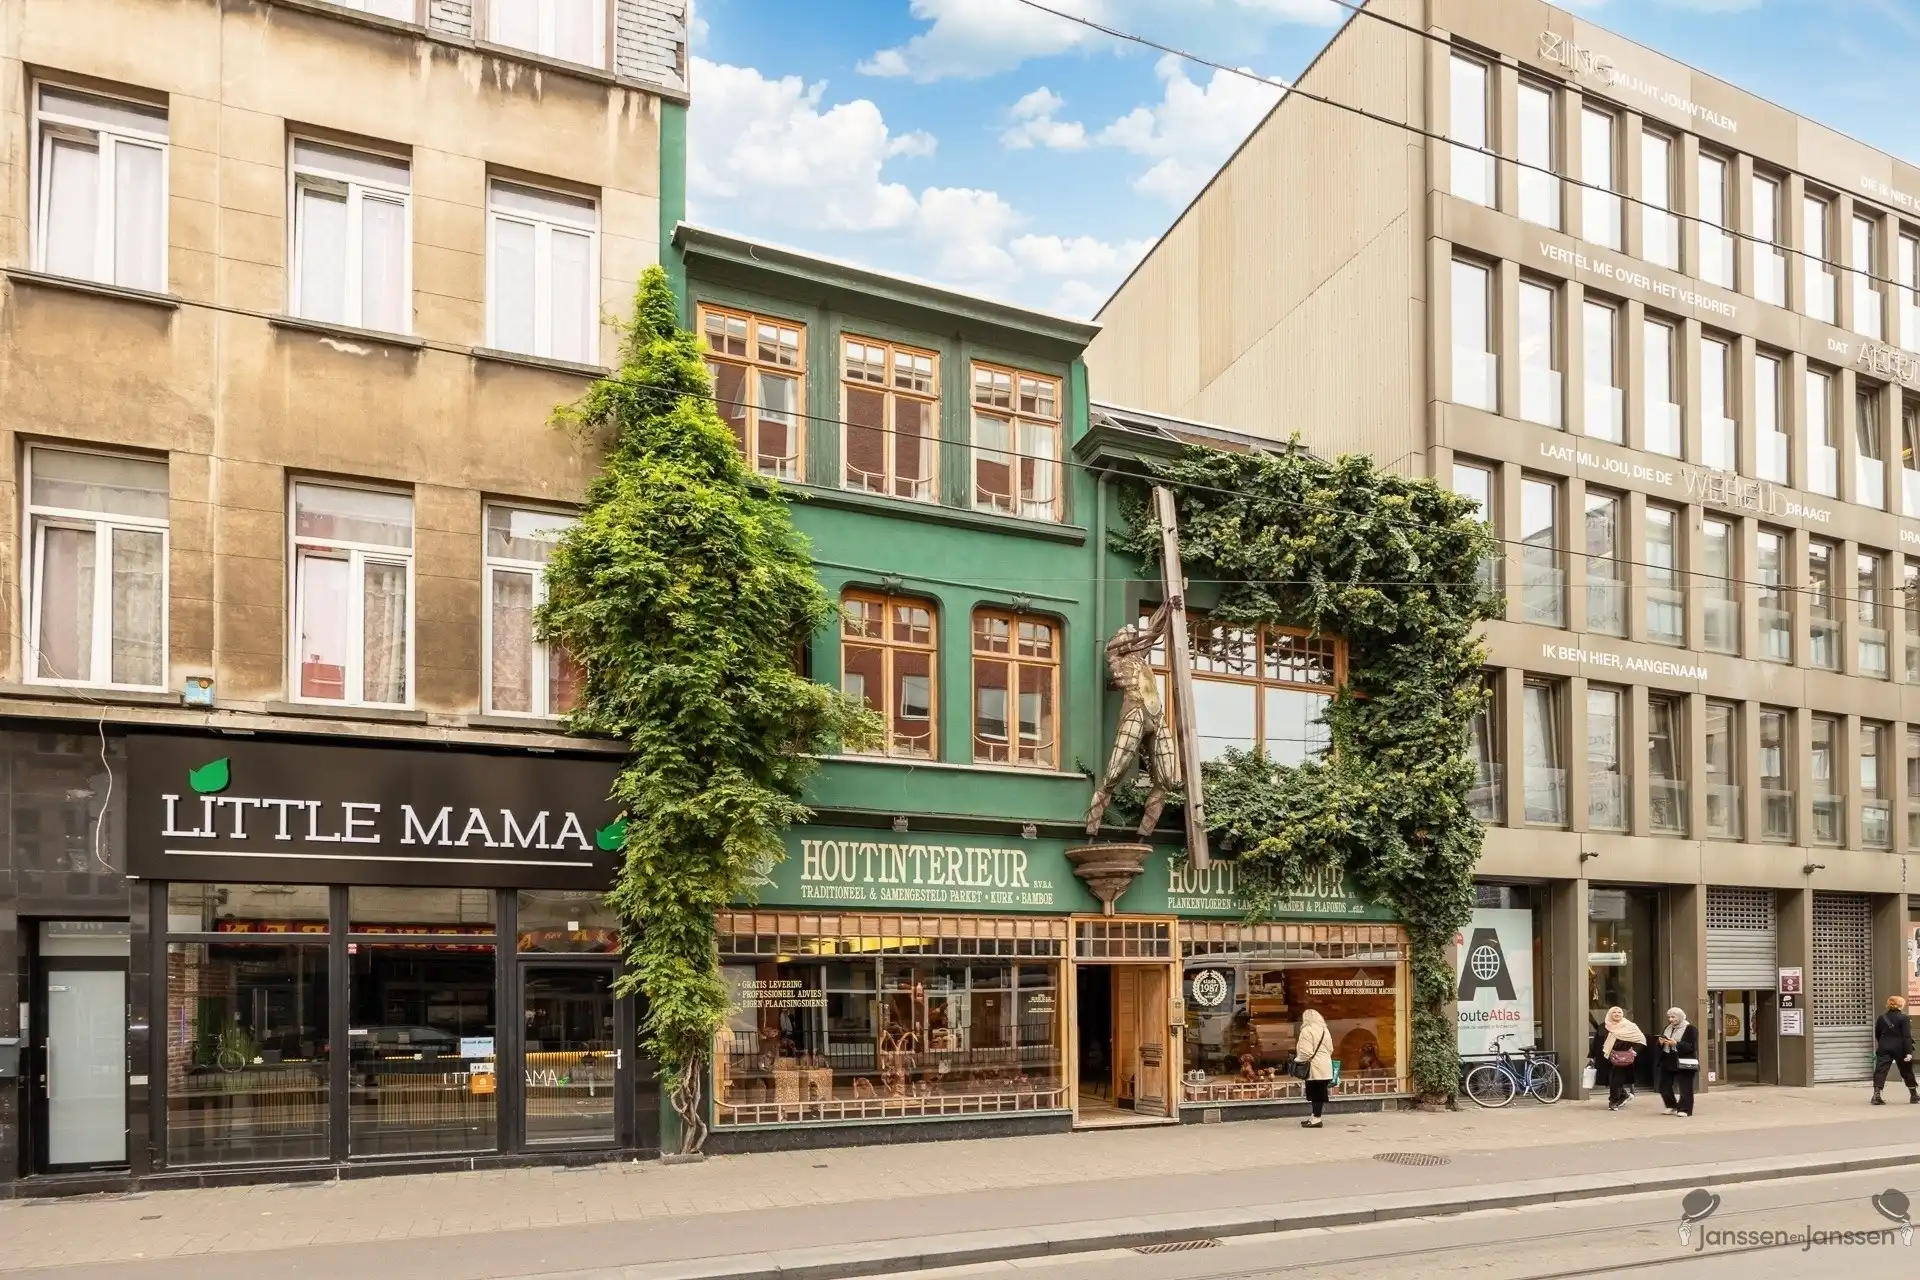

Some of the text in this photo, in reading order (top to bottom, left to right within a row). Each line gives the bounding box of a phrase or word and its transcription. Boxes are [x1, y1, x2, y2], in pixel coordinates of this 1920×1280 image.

[1614, 69, 1637, 89] MIJ
[1639, 82, 1659, 99] UIT
[1660, 92, 1698, 116] JOUW
[1699, 106, 1737, 133] TALEN
[1861, 176, 1877, 191] DIE
[1890, 188, 1912, 207] NIET
[1539, 242, 1737, 319] VERTEL ME OVER HET VERDRIET
[1827, 337, 1849, 355] DAT
[1540, 443, 1574, 462] LAAT
[1576, 452, 1599, 468] MIJ
[1602, 458, 1631, 478] JOU,
[1633, 465, 1654, 482] DIE
[1656, 471, 1673, 486] DE
[1787, 503, 1832, 524] DRAAGT
[1542, 643, 1708, 681] IK BEN HIER, AANGENAAM
[161, 794, 595, 851] LITTLE MAMA
[801, 839, 1030, 888] HOUTINTERIEUR
[801, 885, 1054, 905] TRADITIONEEL & SAMENGESTELD PARKET KURK BAMBOE
[1168, 897, 1231, 910] PLANKENVLOEREN
[1278, 901, 1304, 912] WANDEN
[1306, 901, 1313, 912] &
[1314, 902, 1347, 913] PLAFONDS
[742, 980, 802, 989] GRATIS LEVERING
[742, 989, 821, 998] PROFESSIONEEL ADVIES
[1200, 983, 1219, 993] 1987
[742, 999, 828, 1008] EIGEN PLAATSINGSDIENST
